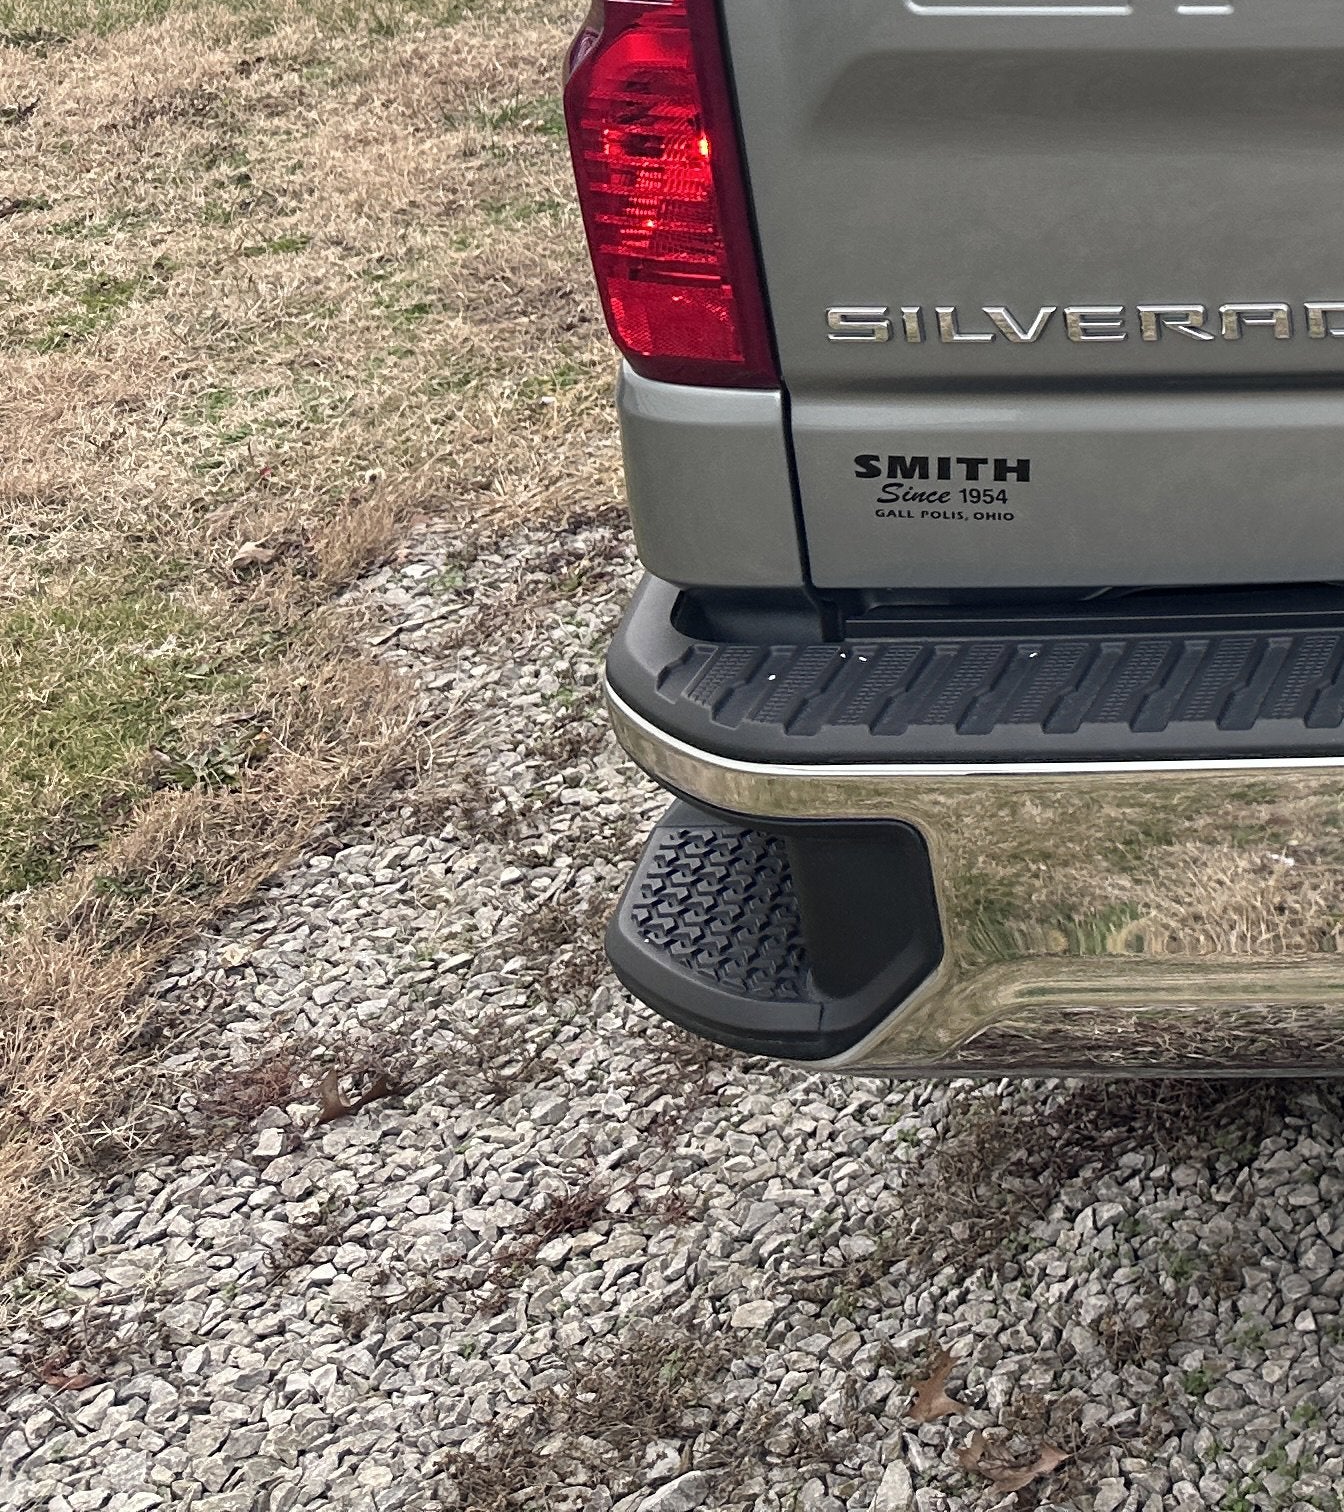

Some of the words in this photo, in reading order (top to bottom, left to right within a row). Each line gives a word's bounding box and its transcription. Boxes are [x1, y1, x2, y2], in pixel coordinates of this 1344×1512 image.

[854, 454, 1031, 482] SMITH
[876, 482, 951, 504] Since
[958, 488, 1009, 505] 1954
[973, 511, 1015, 521] OHIO
